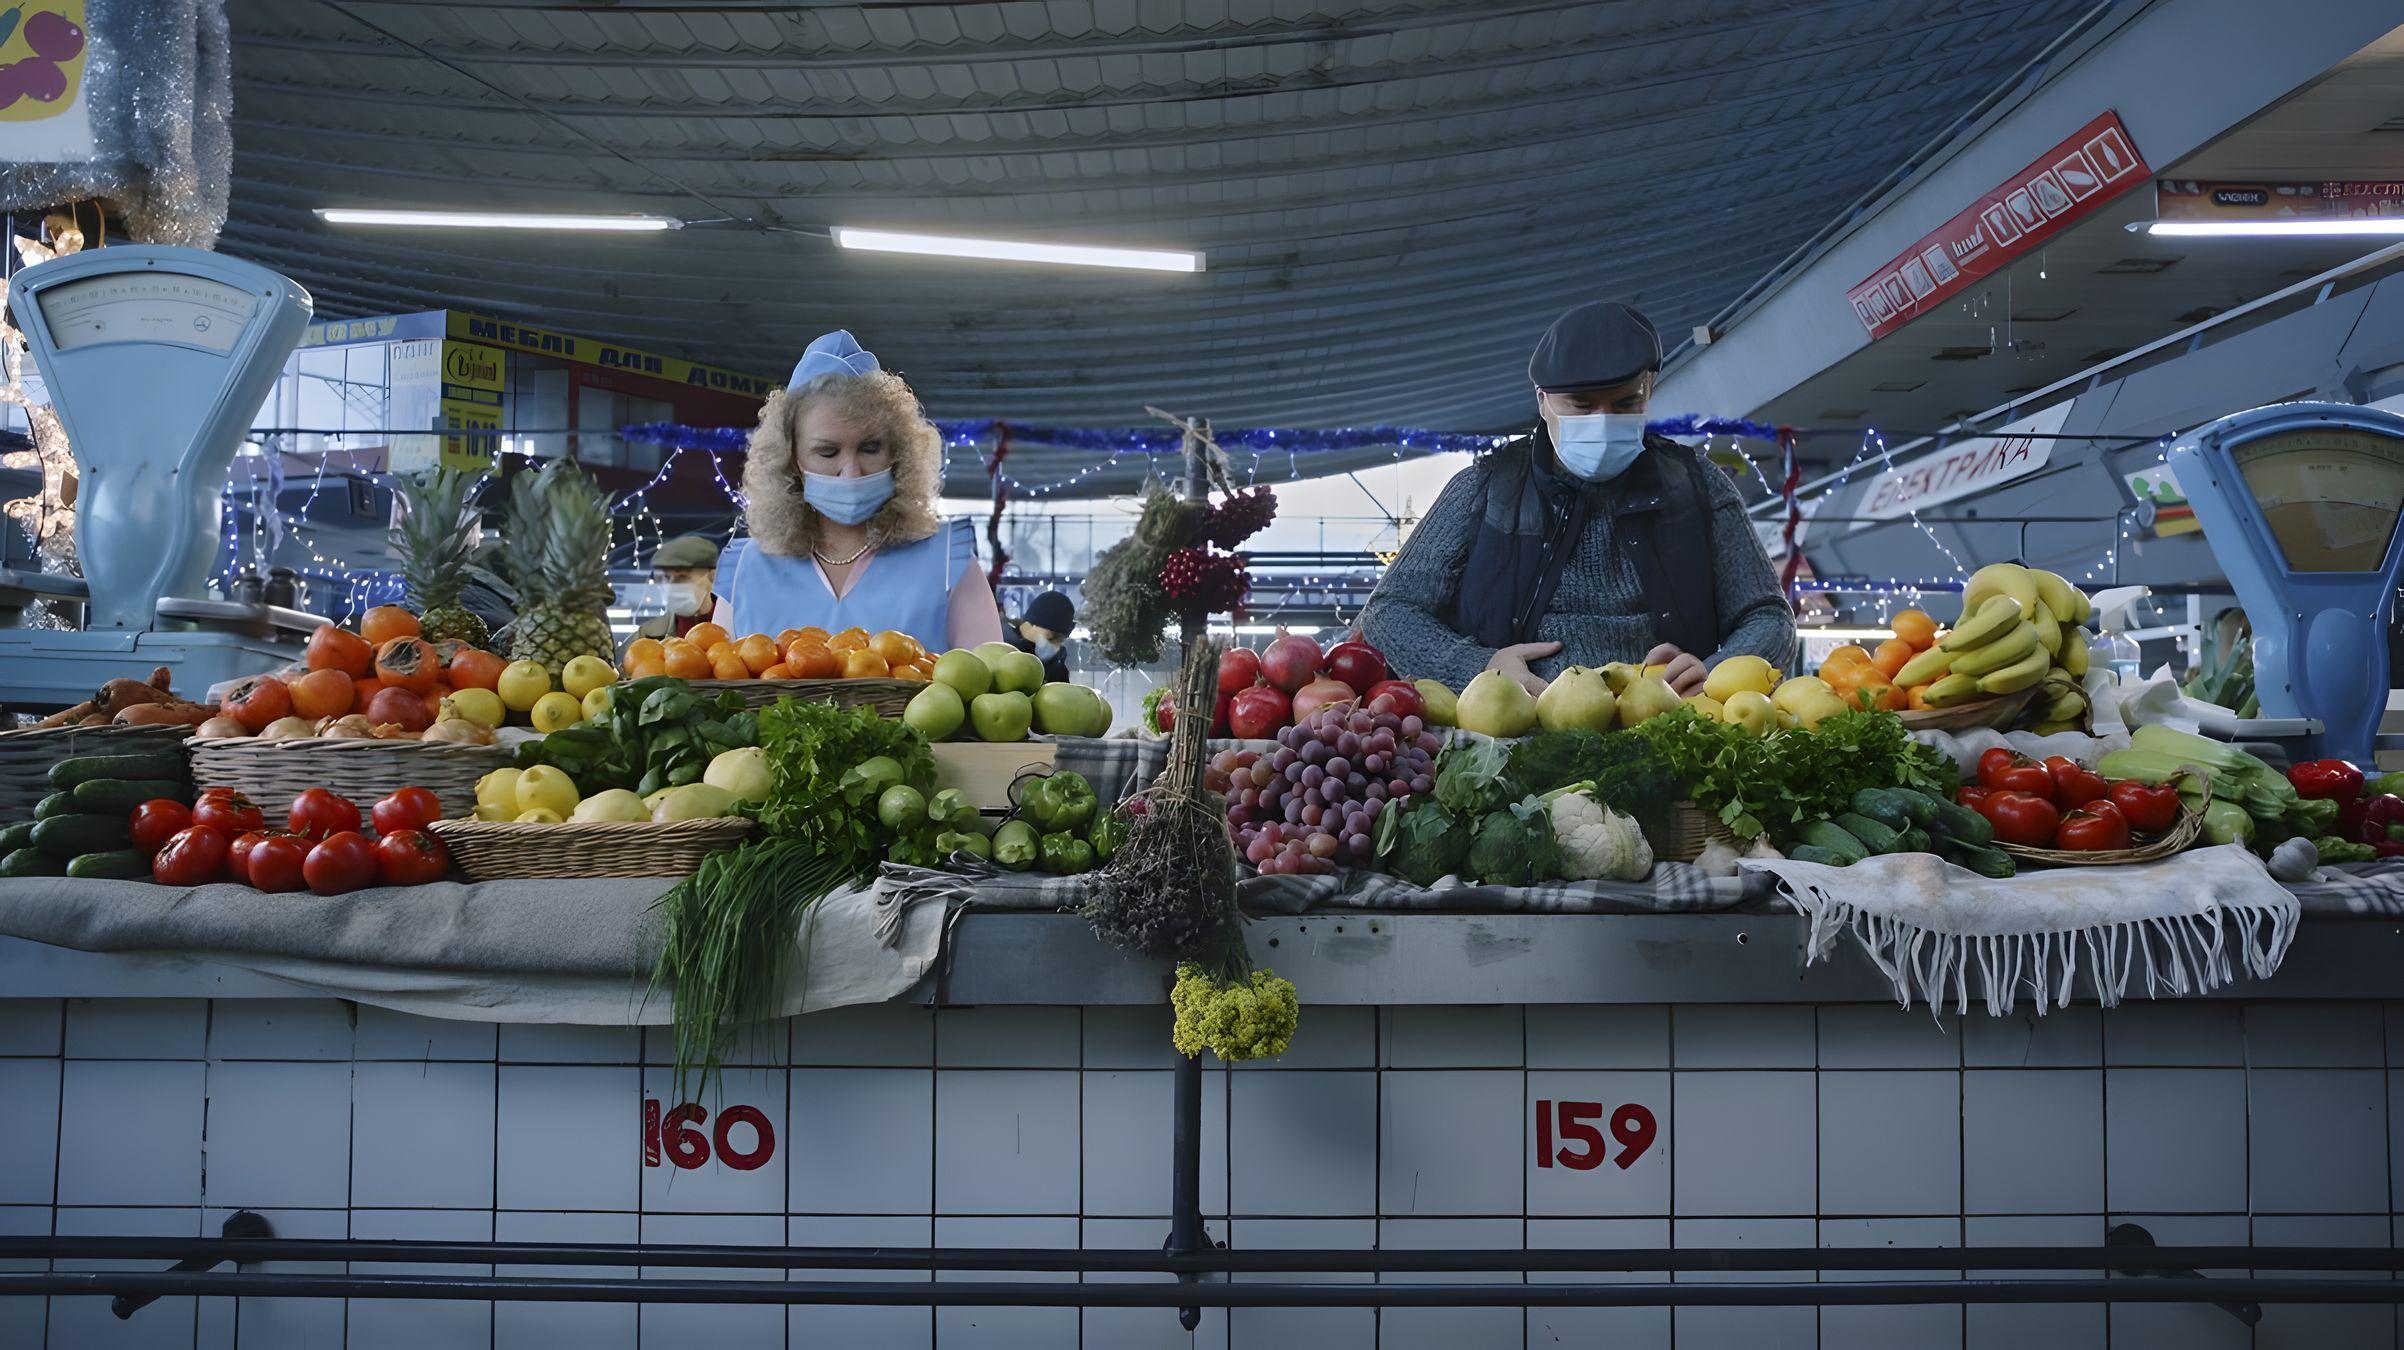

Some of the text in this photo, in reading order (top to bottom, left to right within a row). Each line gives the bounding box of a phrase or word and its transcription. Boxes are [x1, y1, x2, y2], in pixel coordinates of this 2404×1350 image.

[470, 318, 575, 356] МЕБЛІ
[645, 1099, 776, 1170] 160
[1536, 1100, 1657, 1170] 159
